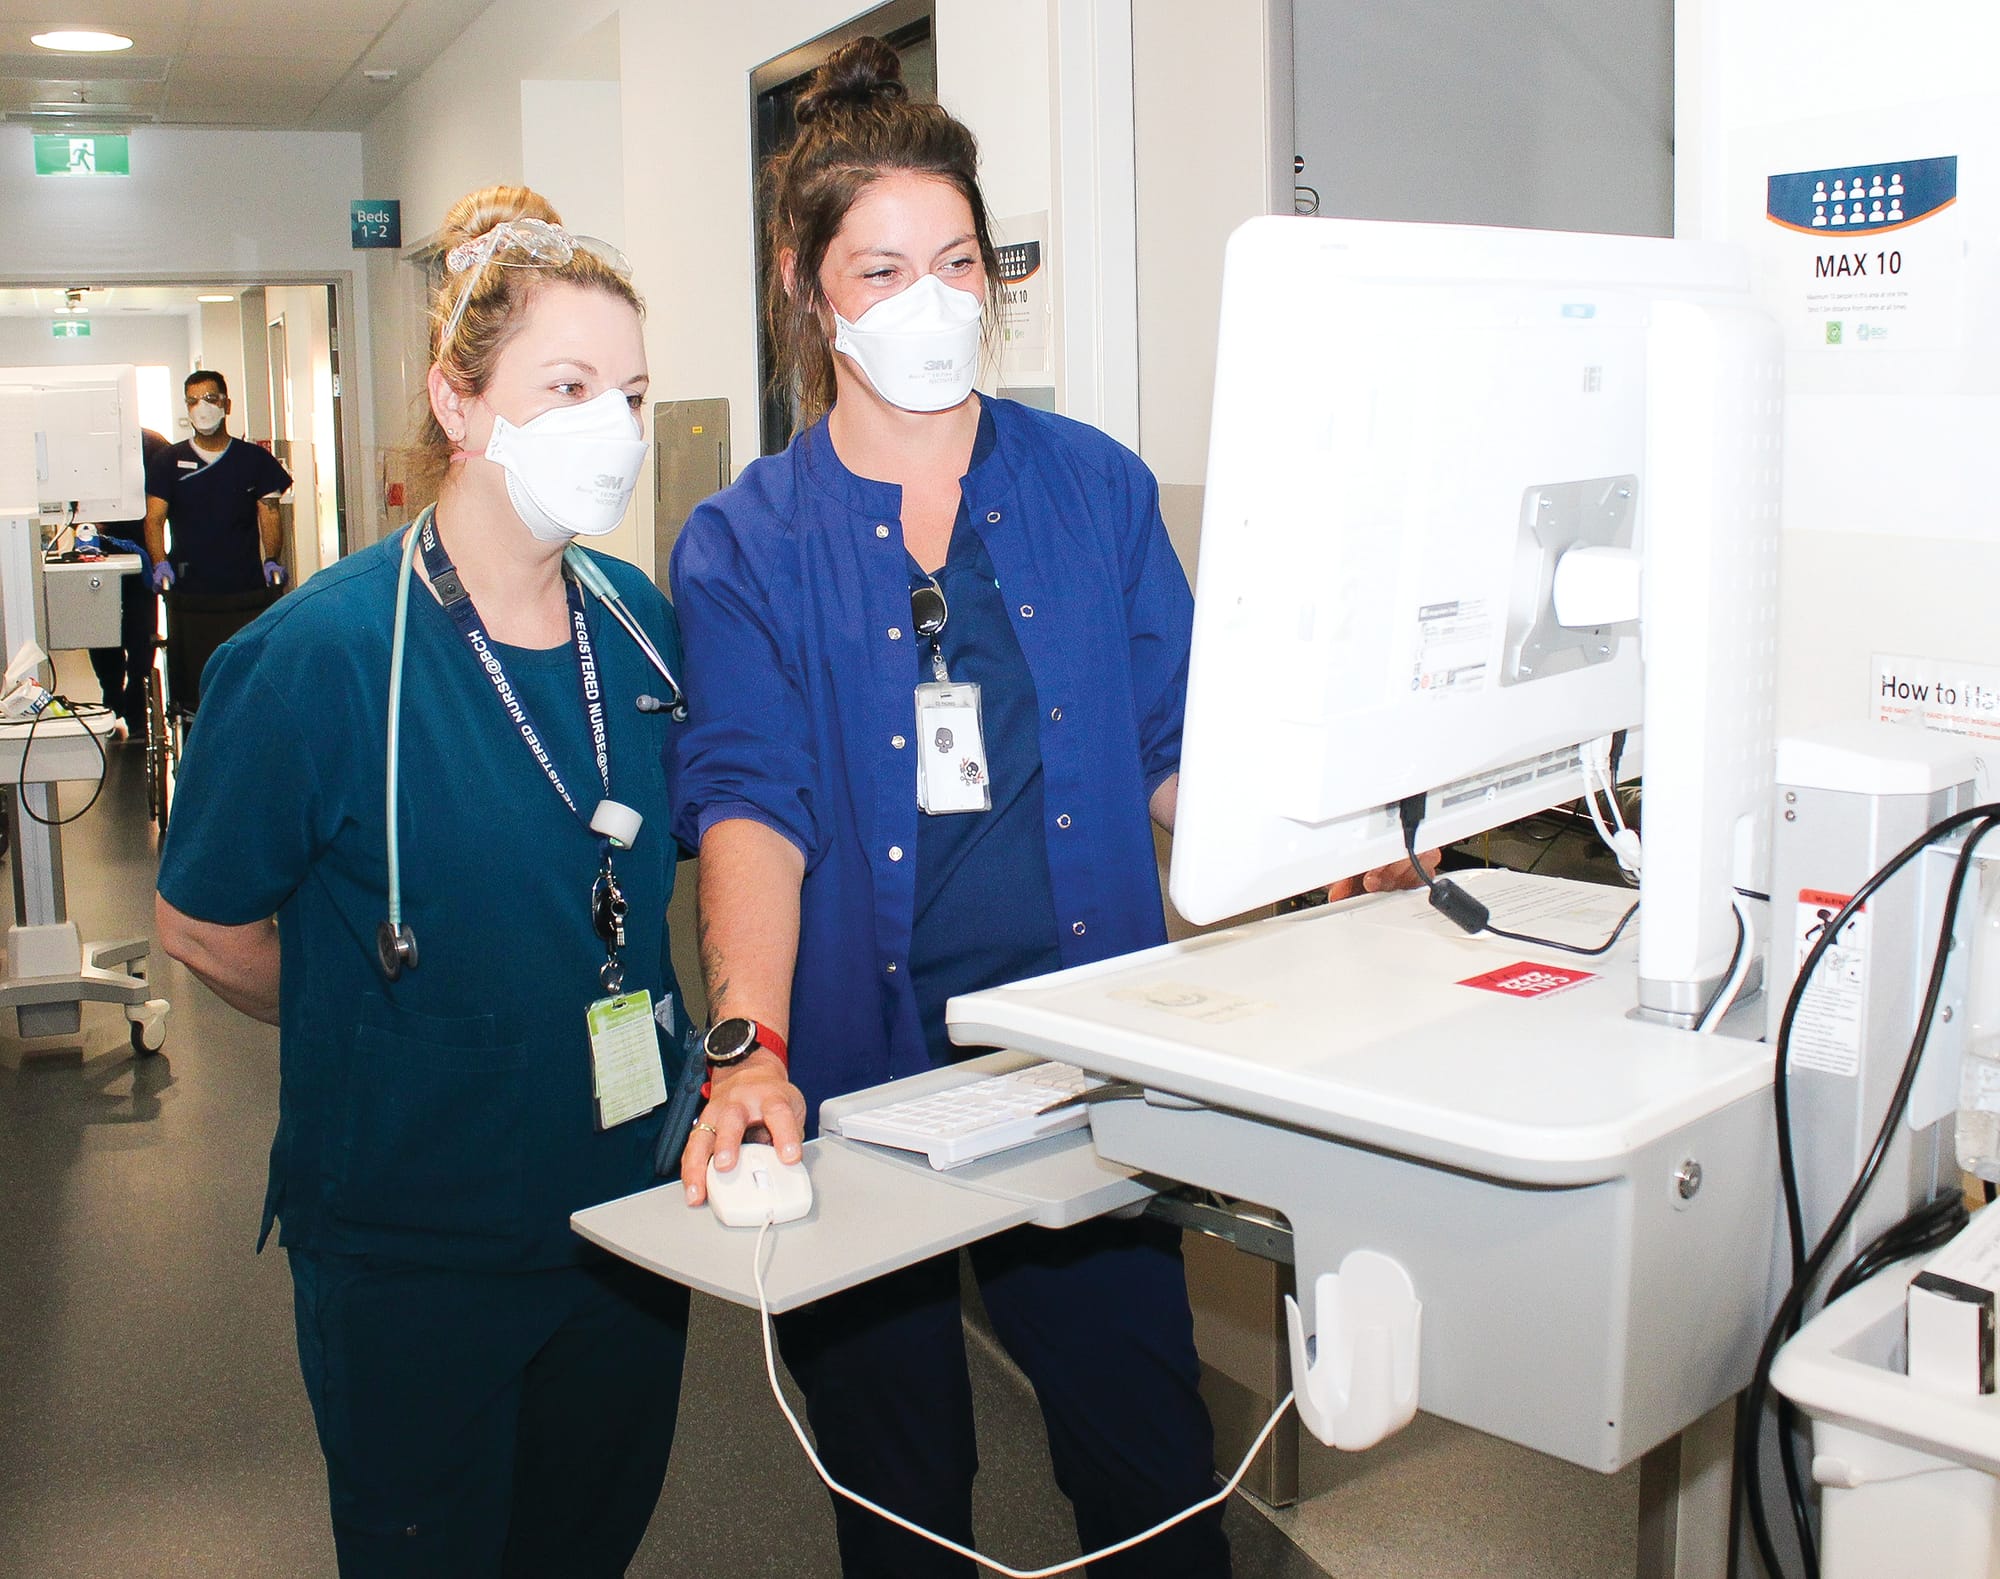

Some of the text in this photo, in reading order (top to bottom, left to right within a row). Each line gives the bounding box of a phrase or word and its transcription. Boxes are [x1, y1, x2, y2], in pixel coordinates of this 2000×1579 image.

[357, 209, 390, 223] Beds
[1815, 250, 1902, 278] MAX 10
[1019, 289, 1028, 303] 10
[924, 359, 953, 371] 3M
[594, 473, 625, 490] 3M
[574, 609, 600, 701] REGISTERED
[468, 629, 526, 724] NURSE@BCH
[1881, 674, 1929, 702] How
[1936, 683, 1957, 705] to
[1519, 976, 1570, 993] CALL
